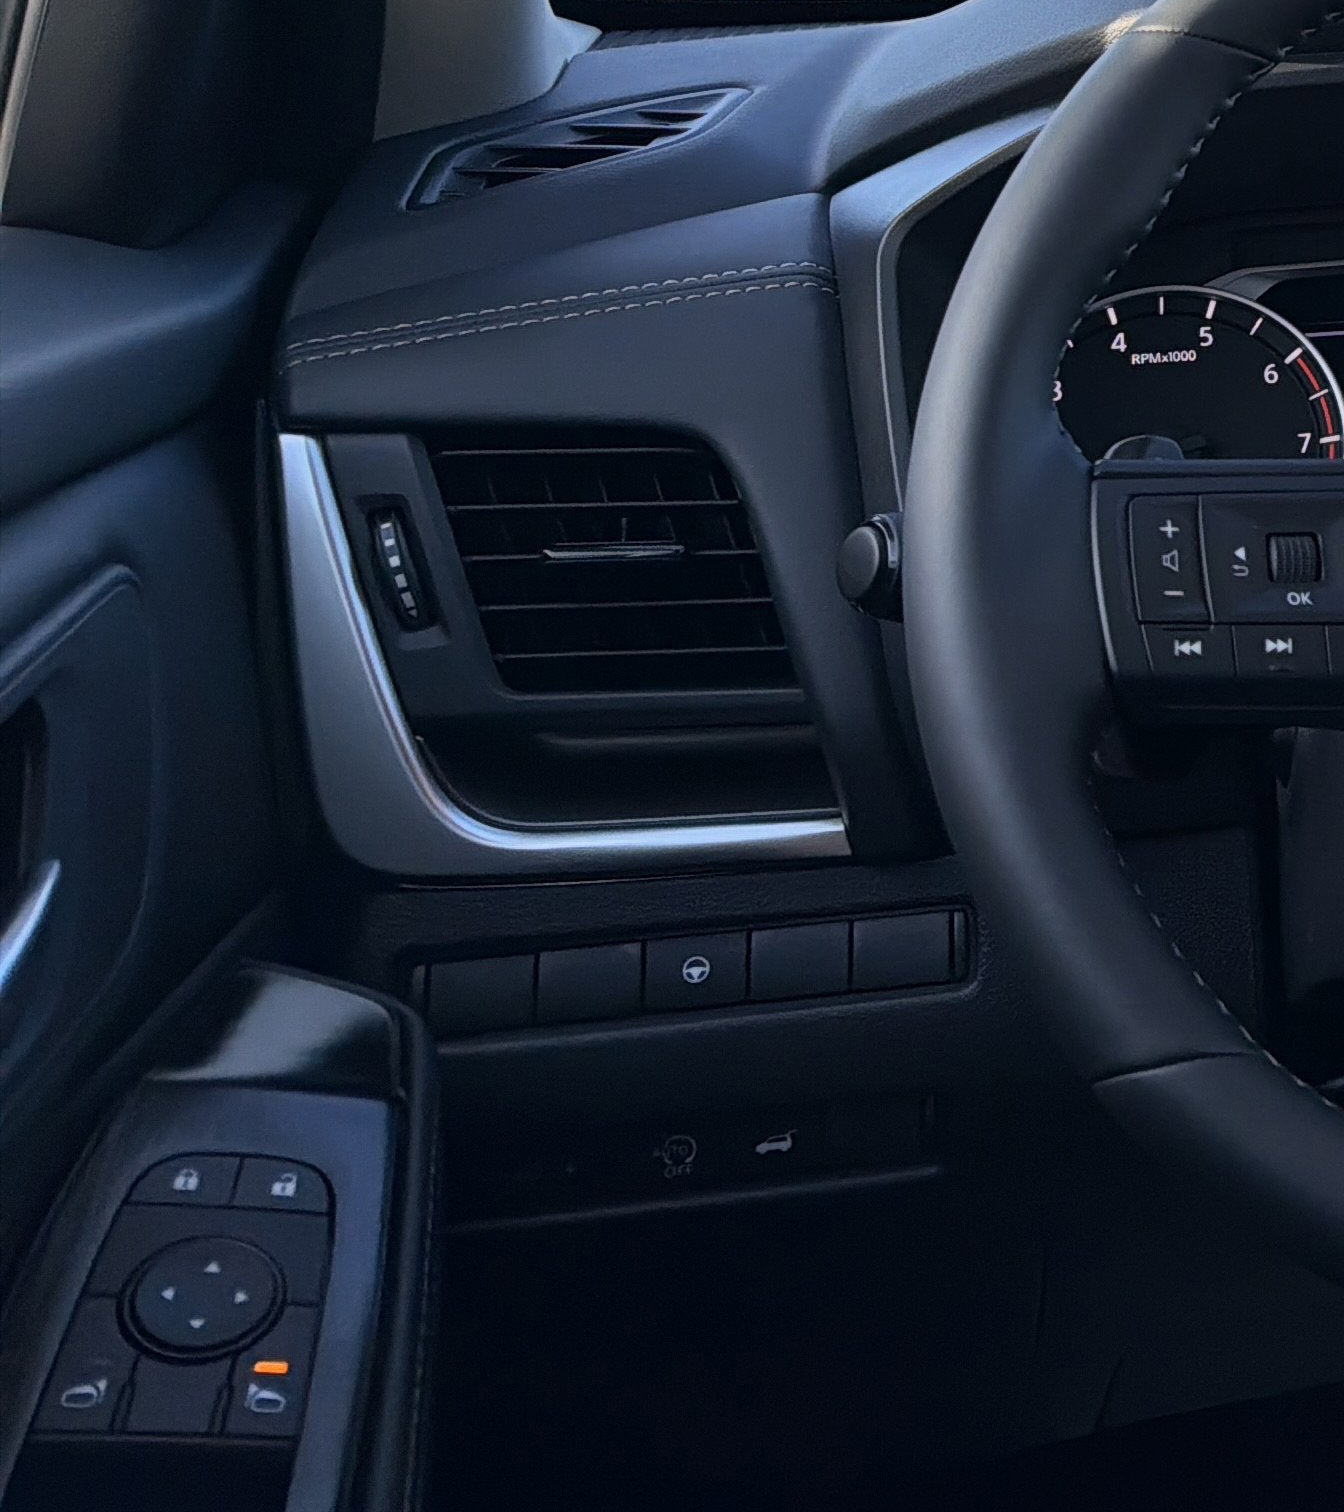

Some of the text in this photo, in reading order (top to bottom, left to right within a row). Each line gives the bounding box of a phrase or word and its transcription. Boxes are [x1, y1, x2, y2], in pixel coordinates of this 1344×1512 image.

[1111, 332, 1127, 352] 4
[1199, 326, 1213, 347] 5
[1131, 349, 1197, 365] RPMx1000
[1263, 363, 1279, 384] 6
[1297, 433, 1312, 454] 7
